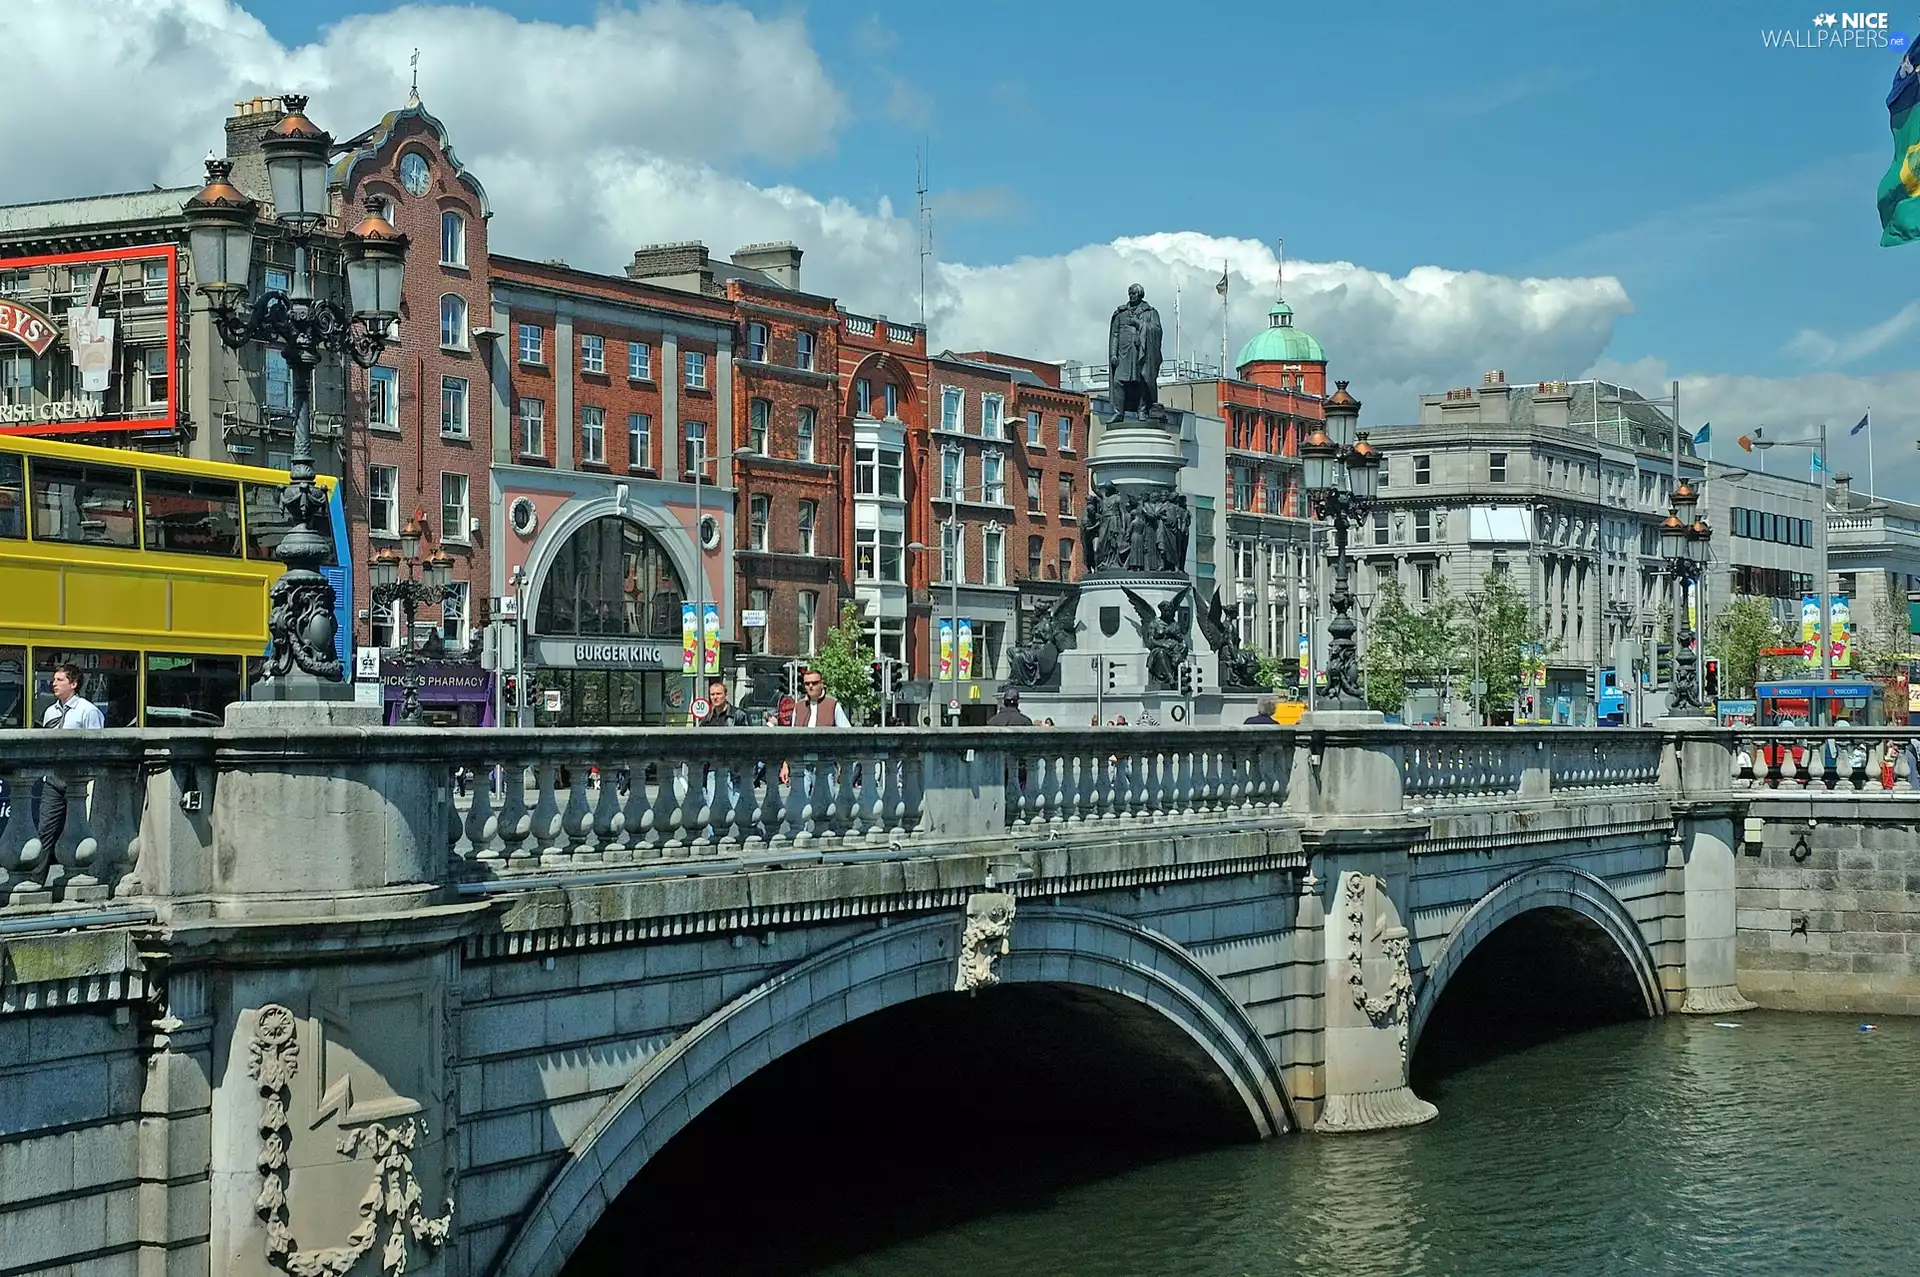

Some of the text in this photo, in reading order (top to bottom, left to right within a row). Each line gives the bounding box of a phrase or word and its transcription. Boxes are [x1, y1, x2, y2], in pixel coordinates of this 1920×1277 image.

[40, 400, 101, 419] CREAM
[576, 645, 661, 662] BURGER KING
[379, 675, 485, 687] HICK'S PHARMACY
[696, 702, 705, 710] 30
